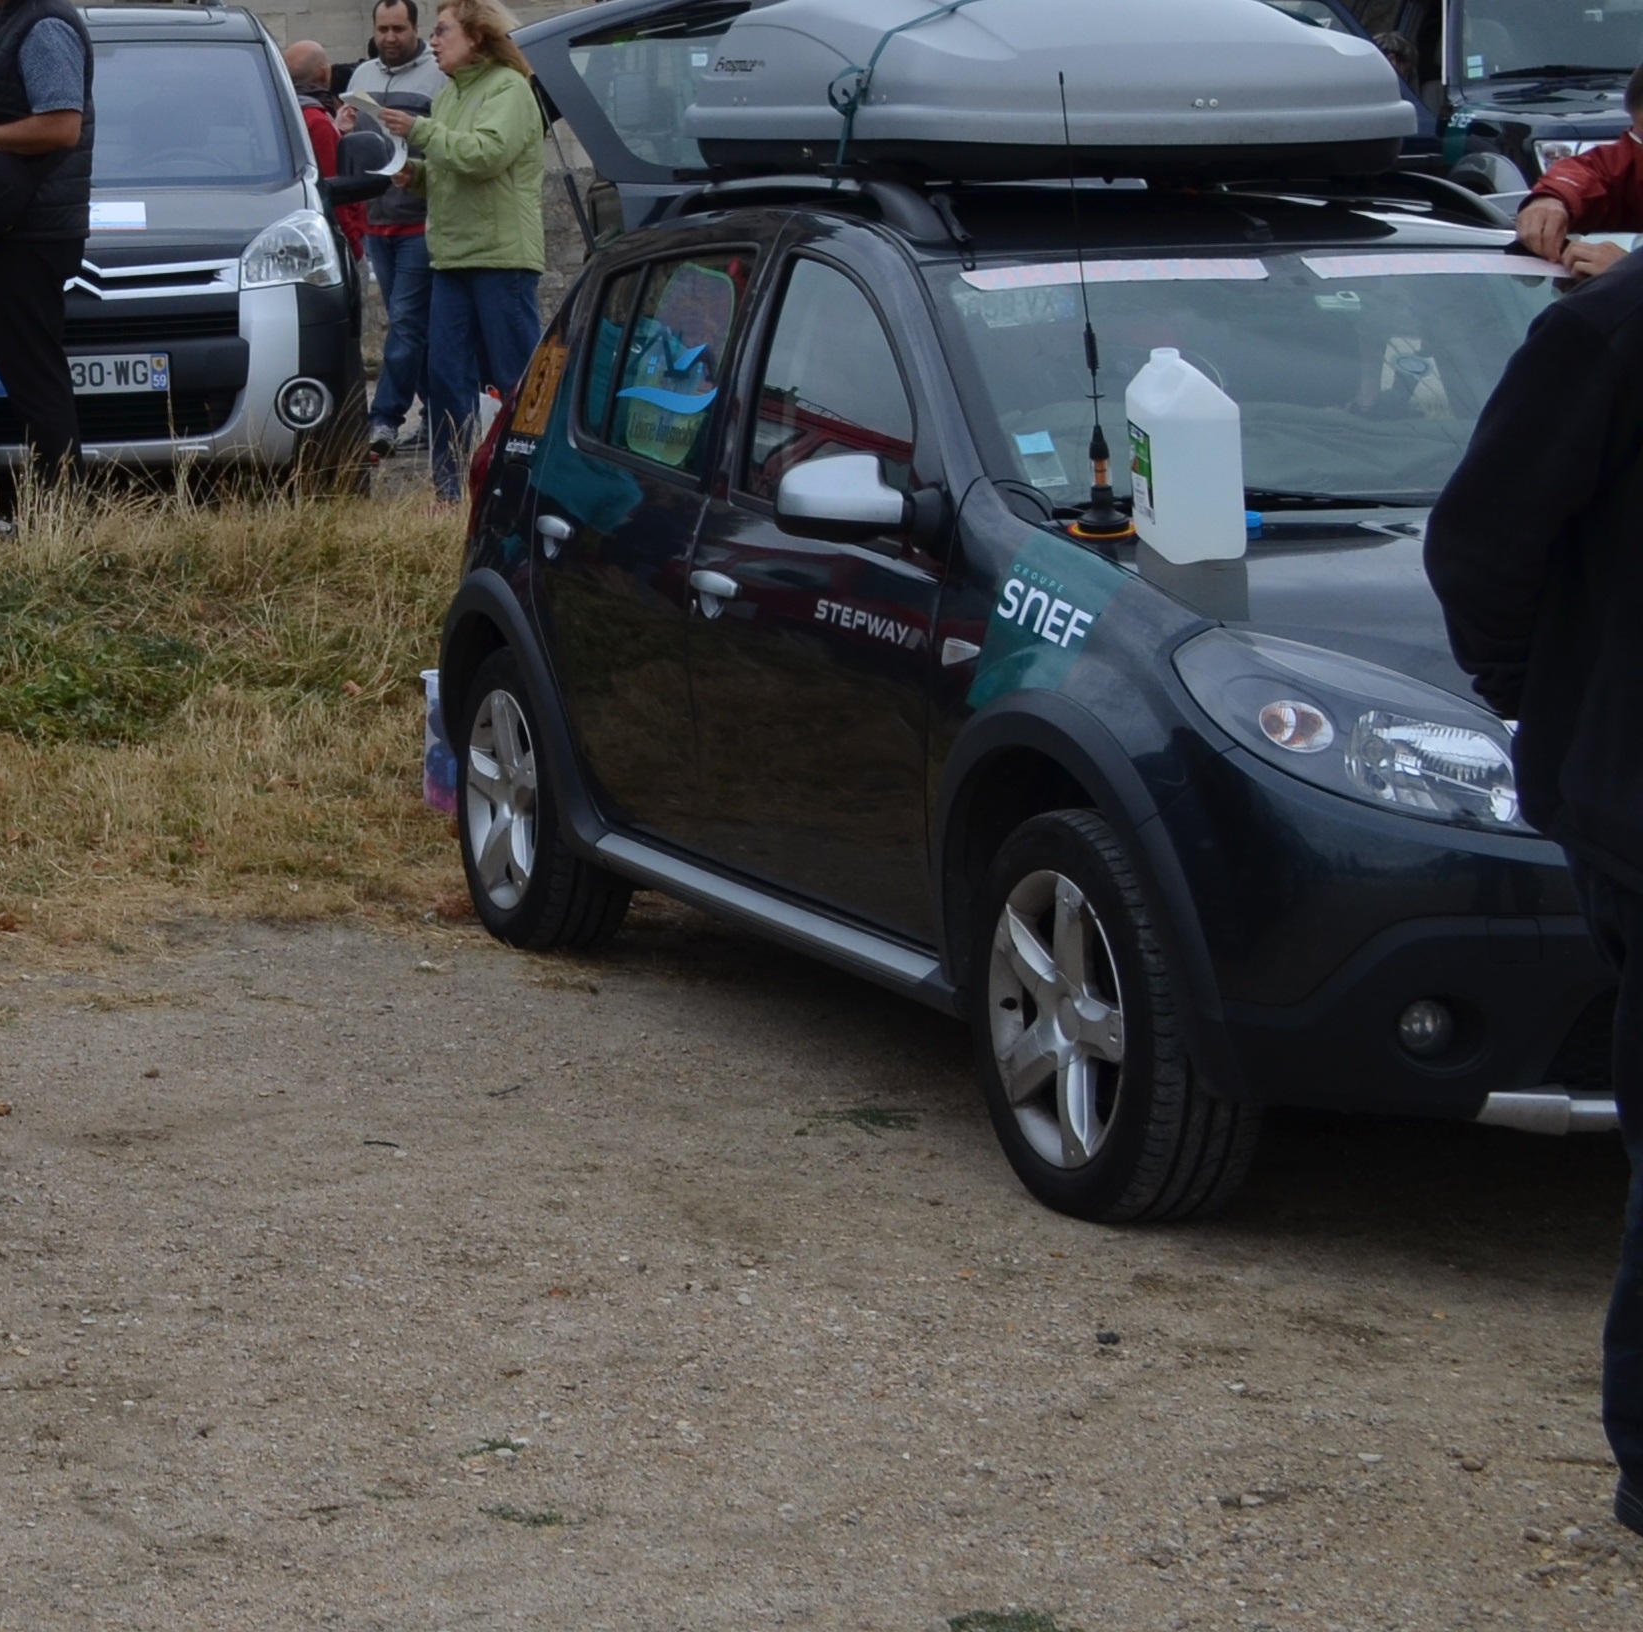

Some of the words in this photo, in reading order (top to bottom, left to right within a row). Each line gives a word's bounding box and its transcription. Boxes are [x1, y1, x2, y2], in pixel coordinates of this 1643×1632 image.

[152, 374, 167, 387] 59
[1013, 564, 1065, 593] GROUPE
[814, 598, 910, 646] STEPWAY
[996, 578, 1095, 648] SNEF
